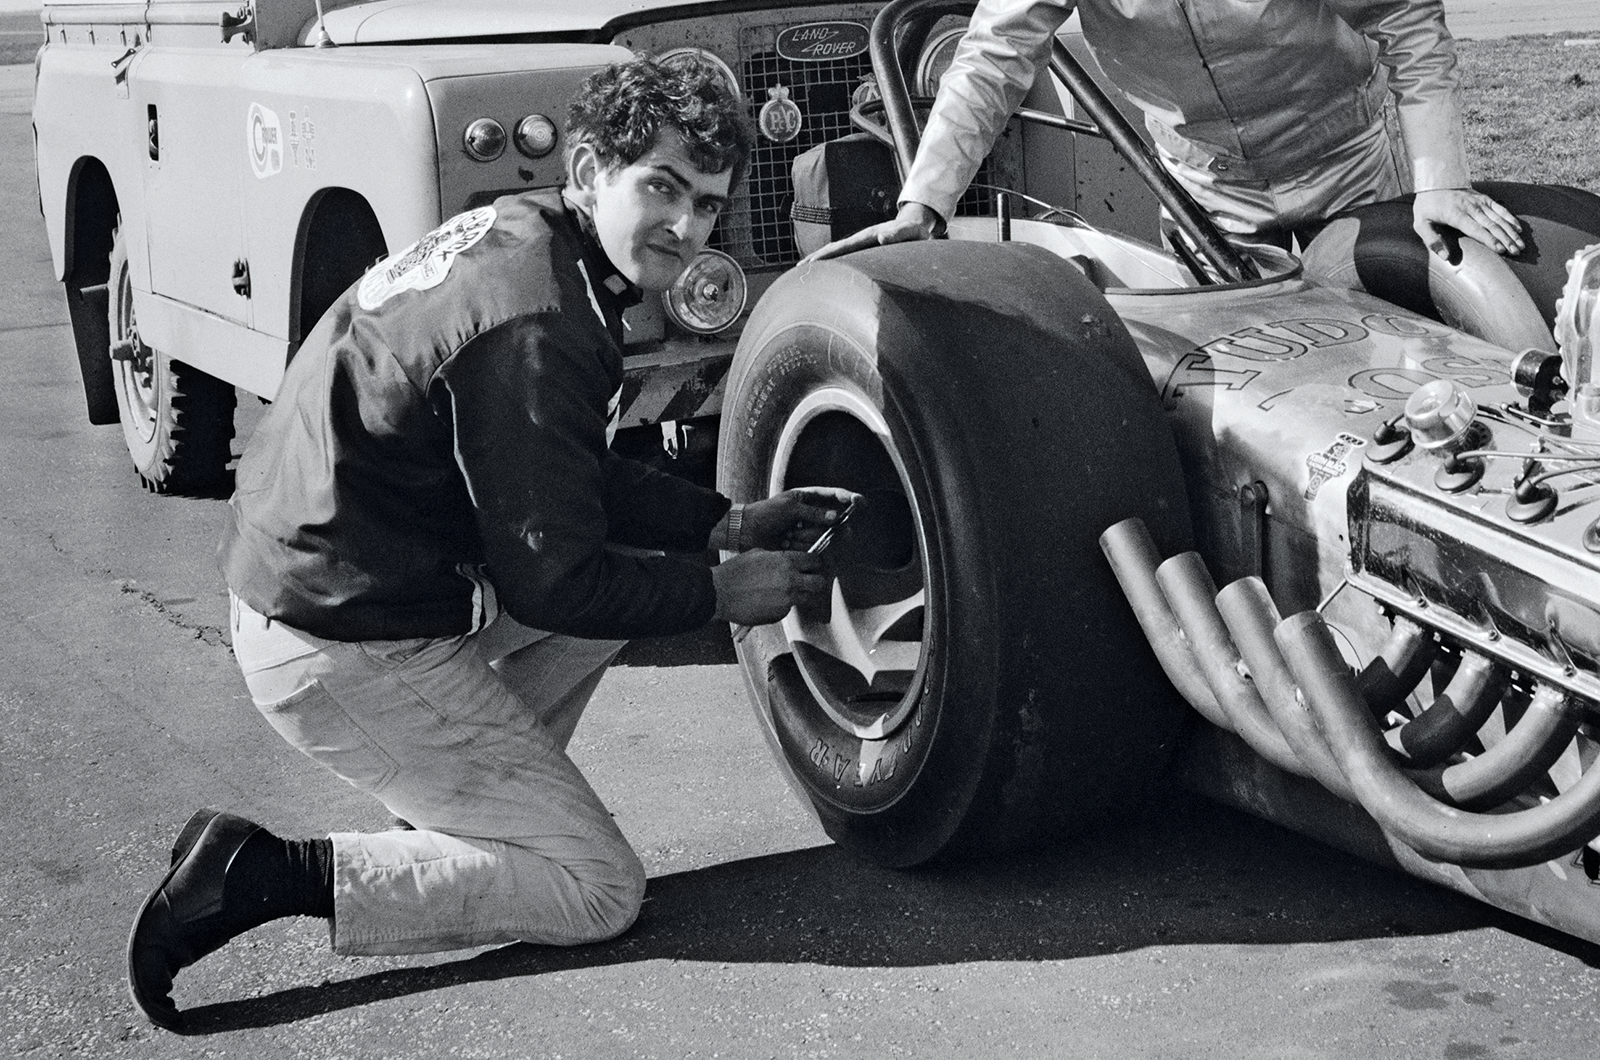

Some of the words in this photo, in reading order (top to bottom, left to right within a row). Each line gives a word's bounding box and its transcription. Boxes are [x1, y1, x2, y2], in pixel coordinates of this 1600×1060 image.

[792, 27, 829, 42] LAND
[813, 41, 856, 56] ROVER
[1161, 313, 1452, 410] TUDO
